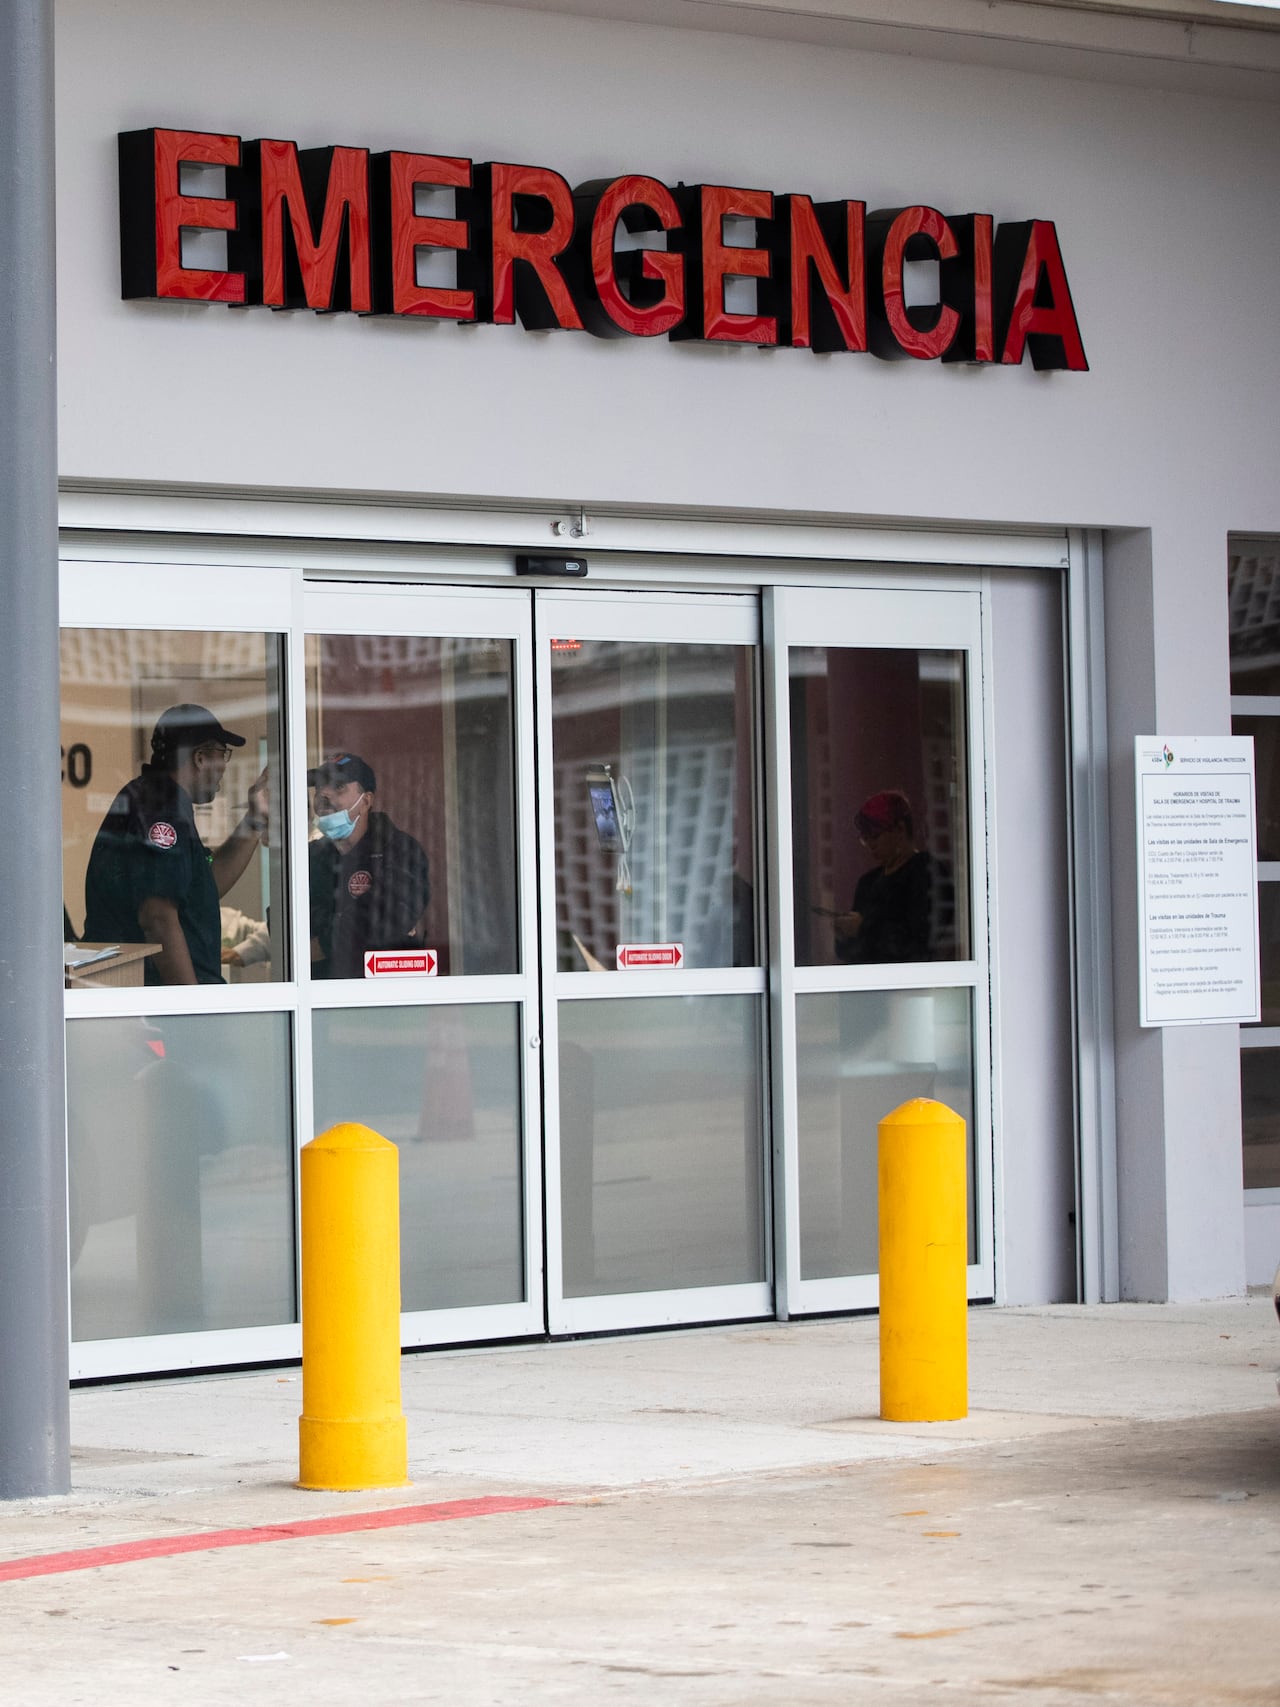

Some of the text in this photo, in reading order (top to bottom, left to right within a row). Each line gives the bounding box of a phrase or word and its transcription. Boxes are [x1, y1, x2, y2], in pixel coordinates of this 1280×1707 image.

[120, 127, 1090, 372] EMERGENCIA
[377, 960, 398, 969] AUTOMATIC
[414, 959, 424, 968] DOOR
